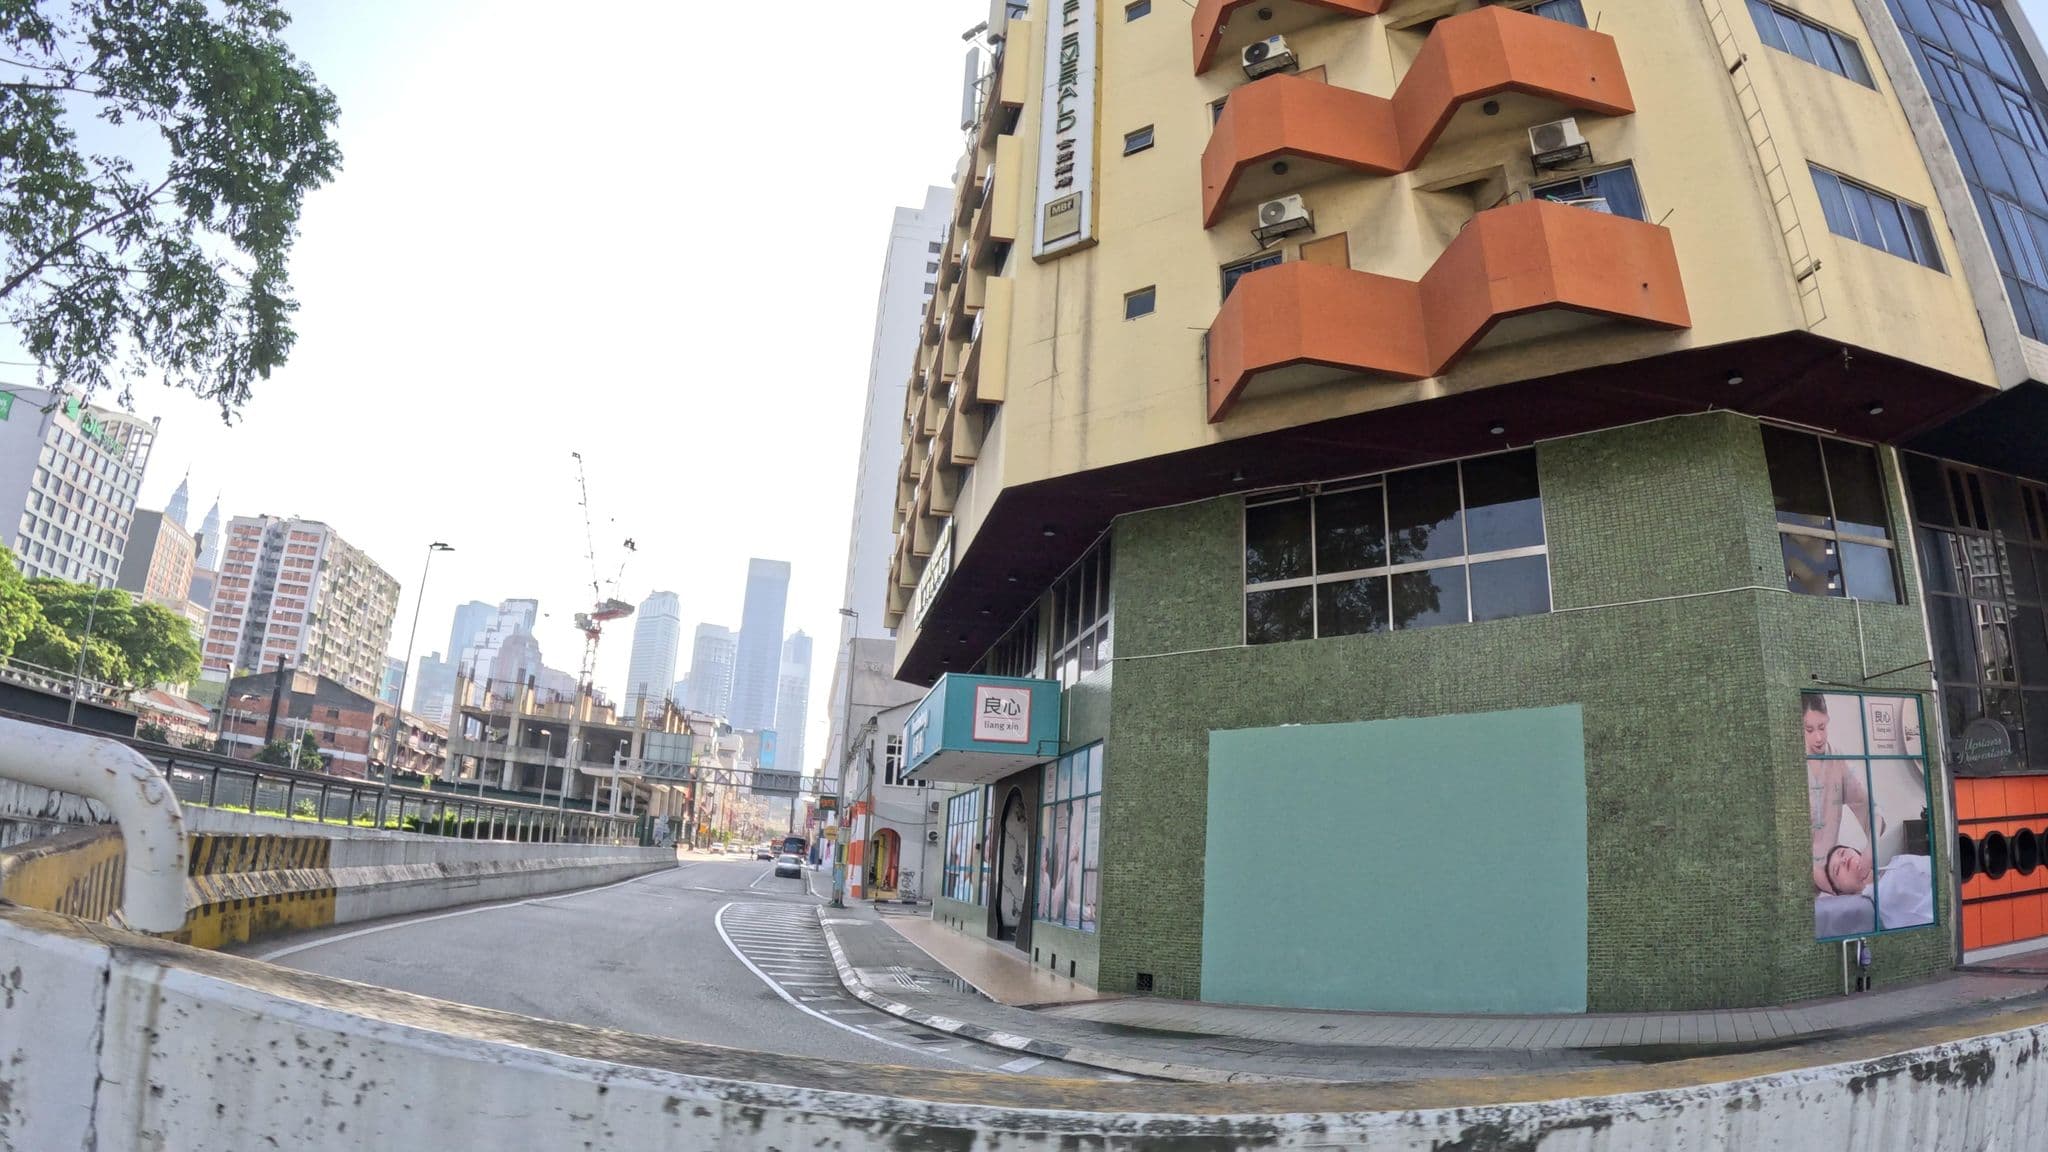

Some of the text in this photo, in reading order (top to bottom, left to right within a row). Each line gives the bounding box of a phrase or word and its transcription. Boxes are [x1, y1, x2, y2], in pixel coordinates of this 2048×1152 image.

[1056, 32, 1079, 134] EMERALD
[983, 697, 1021, 716] 良心
[984, 720, 1019, 731] liang xin
